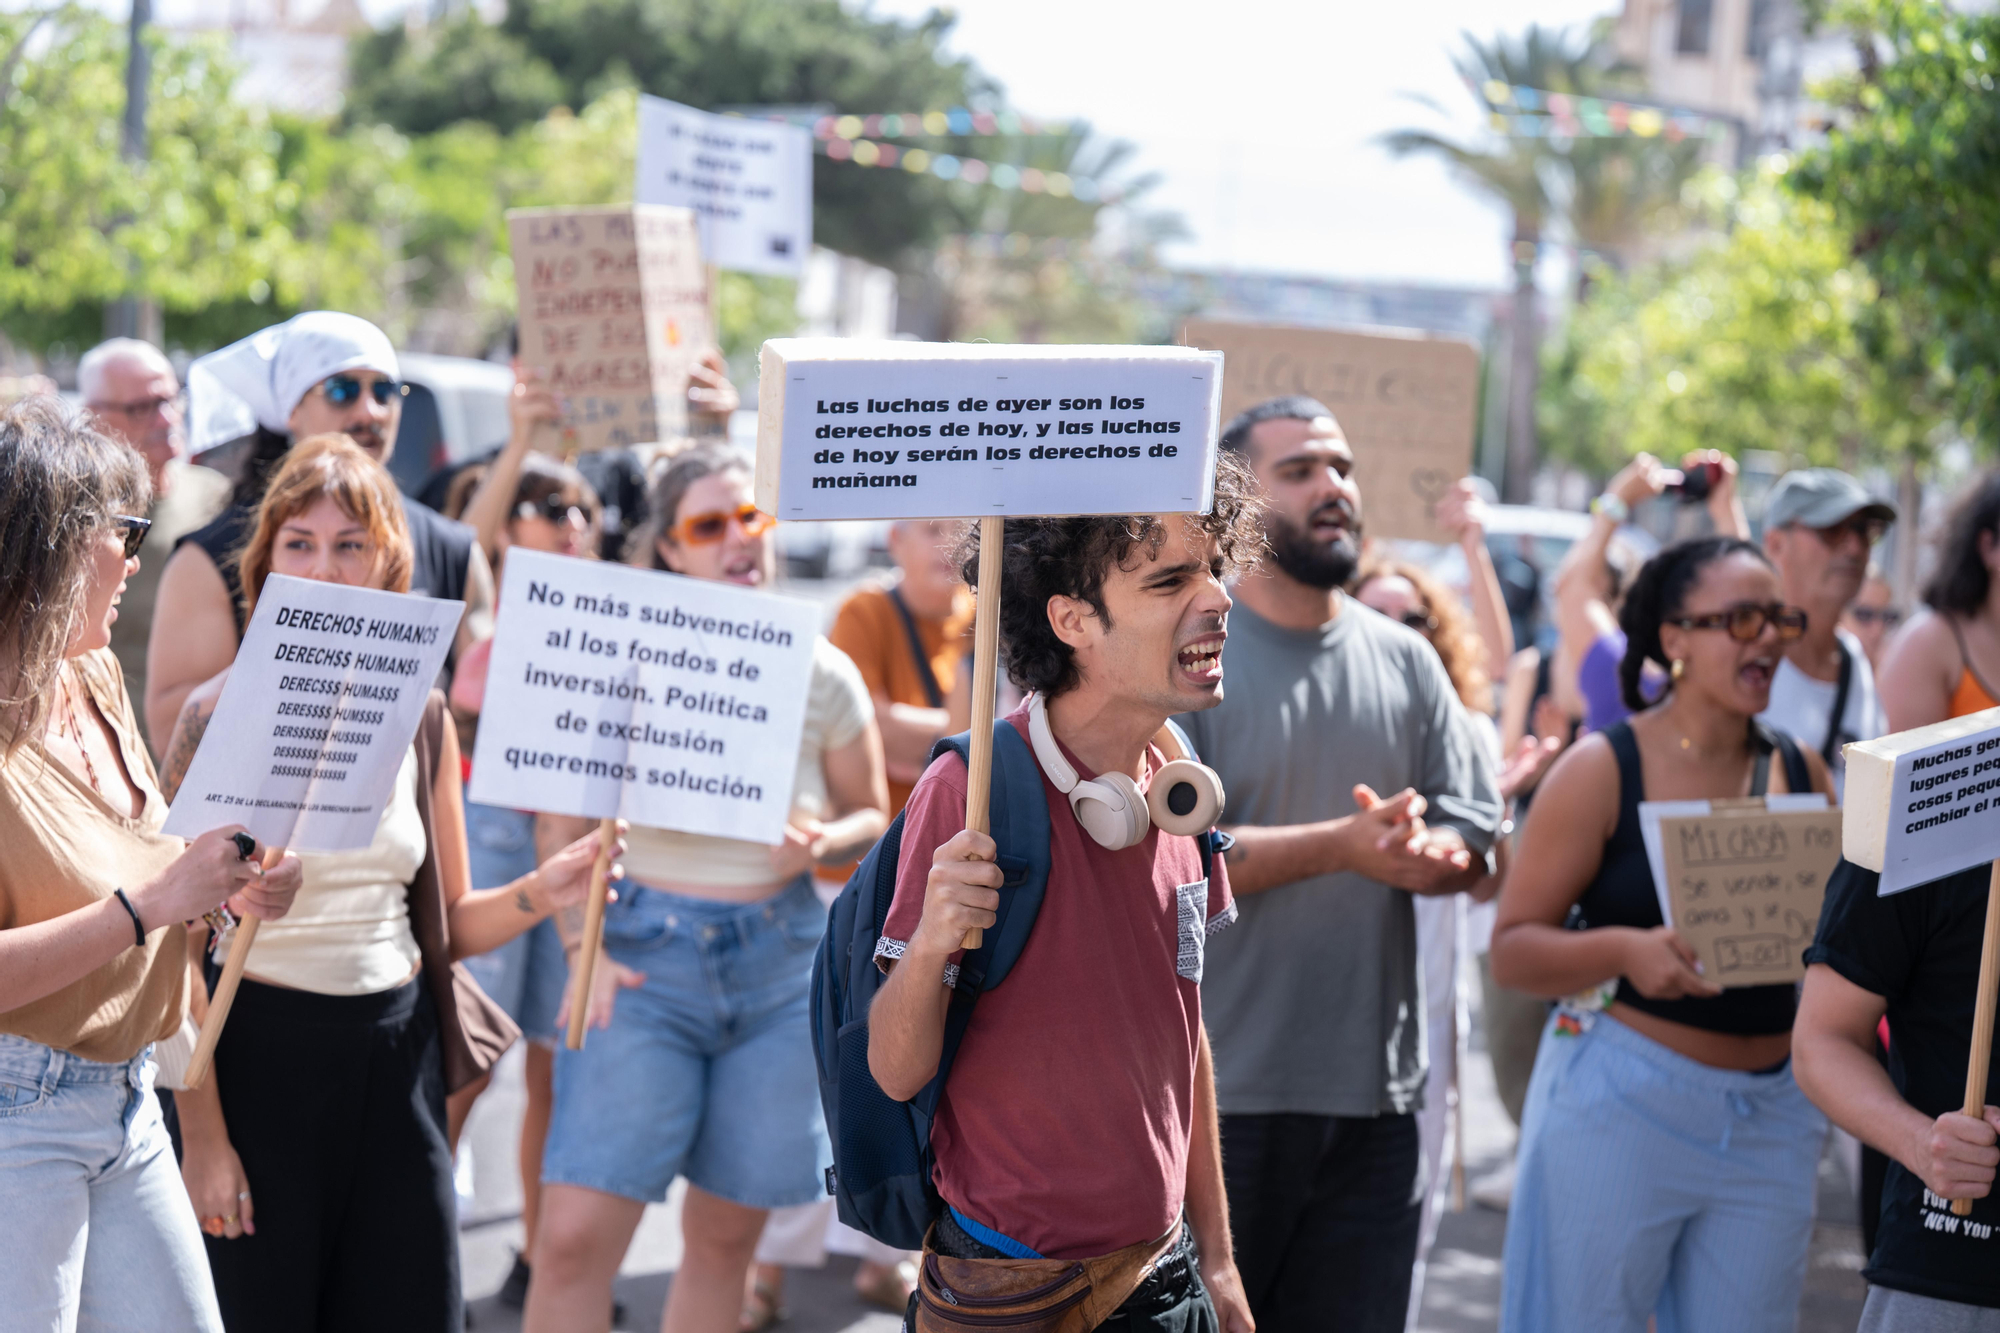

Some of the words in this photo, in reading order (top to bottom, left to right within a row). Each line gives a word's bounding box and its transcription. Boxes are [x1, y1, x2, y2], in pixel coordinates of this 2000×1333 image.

[817, 399, 859, 414] Las
[867, 398, 950, 413] luchas
[957, 397, 989, 412] de
[996, 397, 1052, 414] ayer
[1059, 396, 1102, 410] son
[1110, 395, 1145, 410] los
[815, 423, 931, 439] derechos
[939, 422, 970, 437] de
[978, 421, 1028, 438] hoy,
[1036, 423, 1051, 437] y
[1058, 420, 1094, 435] las
[1101, 419, 1181, 434] luchas
[813, 448, 845, 464] de
[852, 448, 899, 465] hoy
[906, 445, 978, 463] serán
[985, 445, 1021, 461] los
[1028, 443, 1141, 460] derechos
[1148, 443, 1178, 458] de
[812, 472, 917, 489] mañana
[275, 606, 365, 637] DERECHO$
[366, 618, 439, 646] HUMANO$
[527, 581, 565, 608] No
[574, 593, 630, 619] más
[639, 605, 793, 647] subvención
[274, 643, 352, 669] DERECH$$
[353, 652, 420, 677] HUMAN$$
[546, 628, 571, 649] al
[579, 632, 618, 658] los
[627, 639, 717, 675] fondos
[727, 659, 760, 682] de
[279, 675, 342, 697] DEREC$$$
[342, 681, 400, 703] HUMA$$$
[524, 663, 654, 704] inversión.
[664, 686, 768, 723] Política
[555, 710, 588, 734] de
[597, 719, 725, 755] exclusión
[505, 747, 637, 783] queremos
[646, 767, 763, 801] solución
[1912, 745, 1972, 772] Muchas
[1910, 766, 1969, 793] lugares
[205, 792, 223, 804] ART.
[224, 795, 234, 805] 25
[235, 797, 245, 806] DE
[245, 798, 254, 807] LA
[1907, 791, 1953, 813] cosas
[1905, 805, 1970, 834] cambiar
[1974, 798, 1989, 813] el
[1679, 823, 1721, 861] MI
[1803, 825, 1834, 848] no
